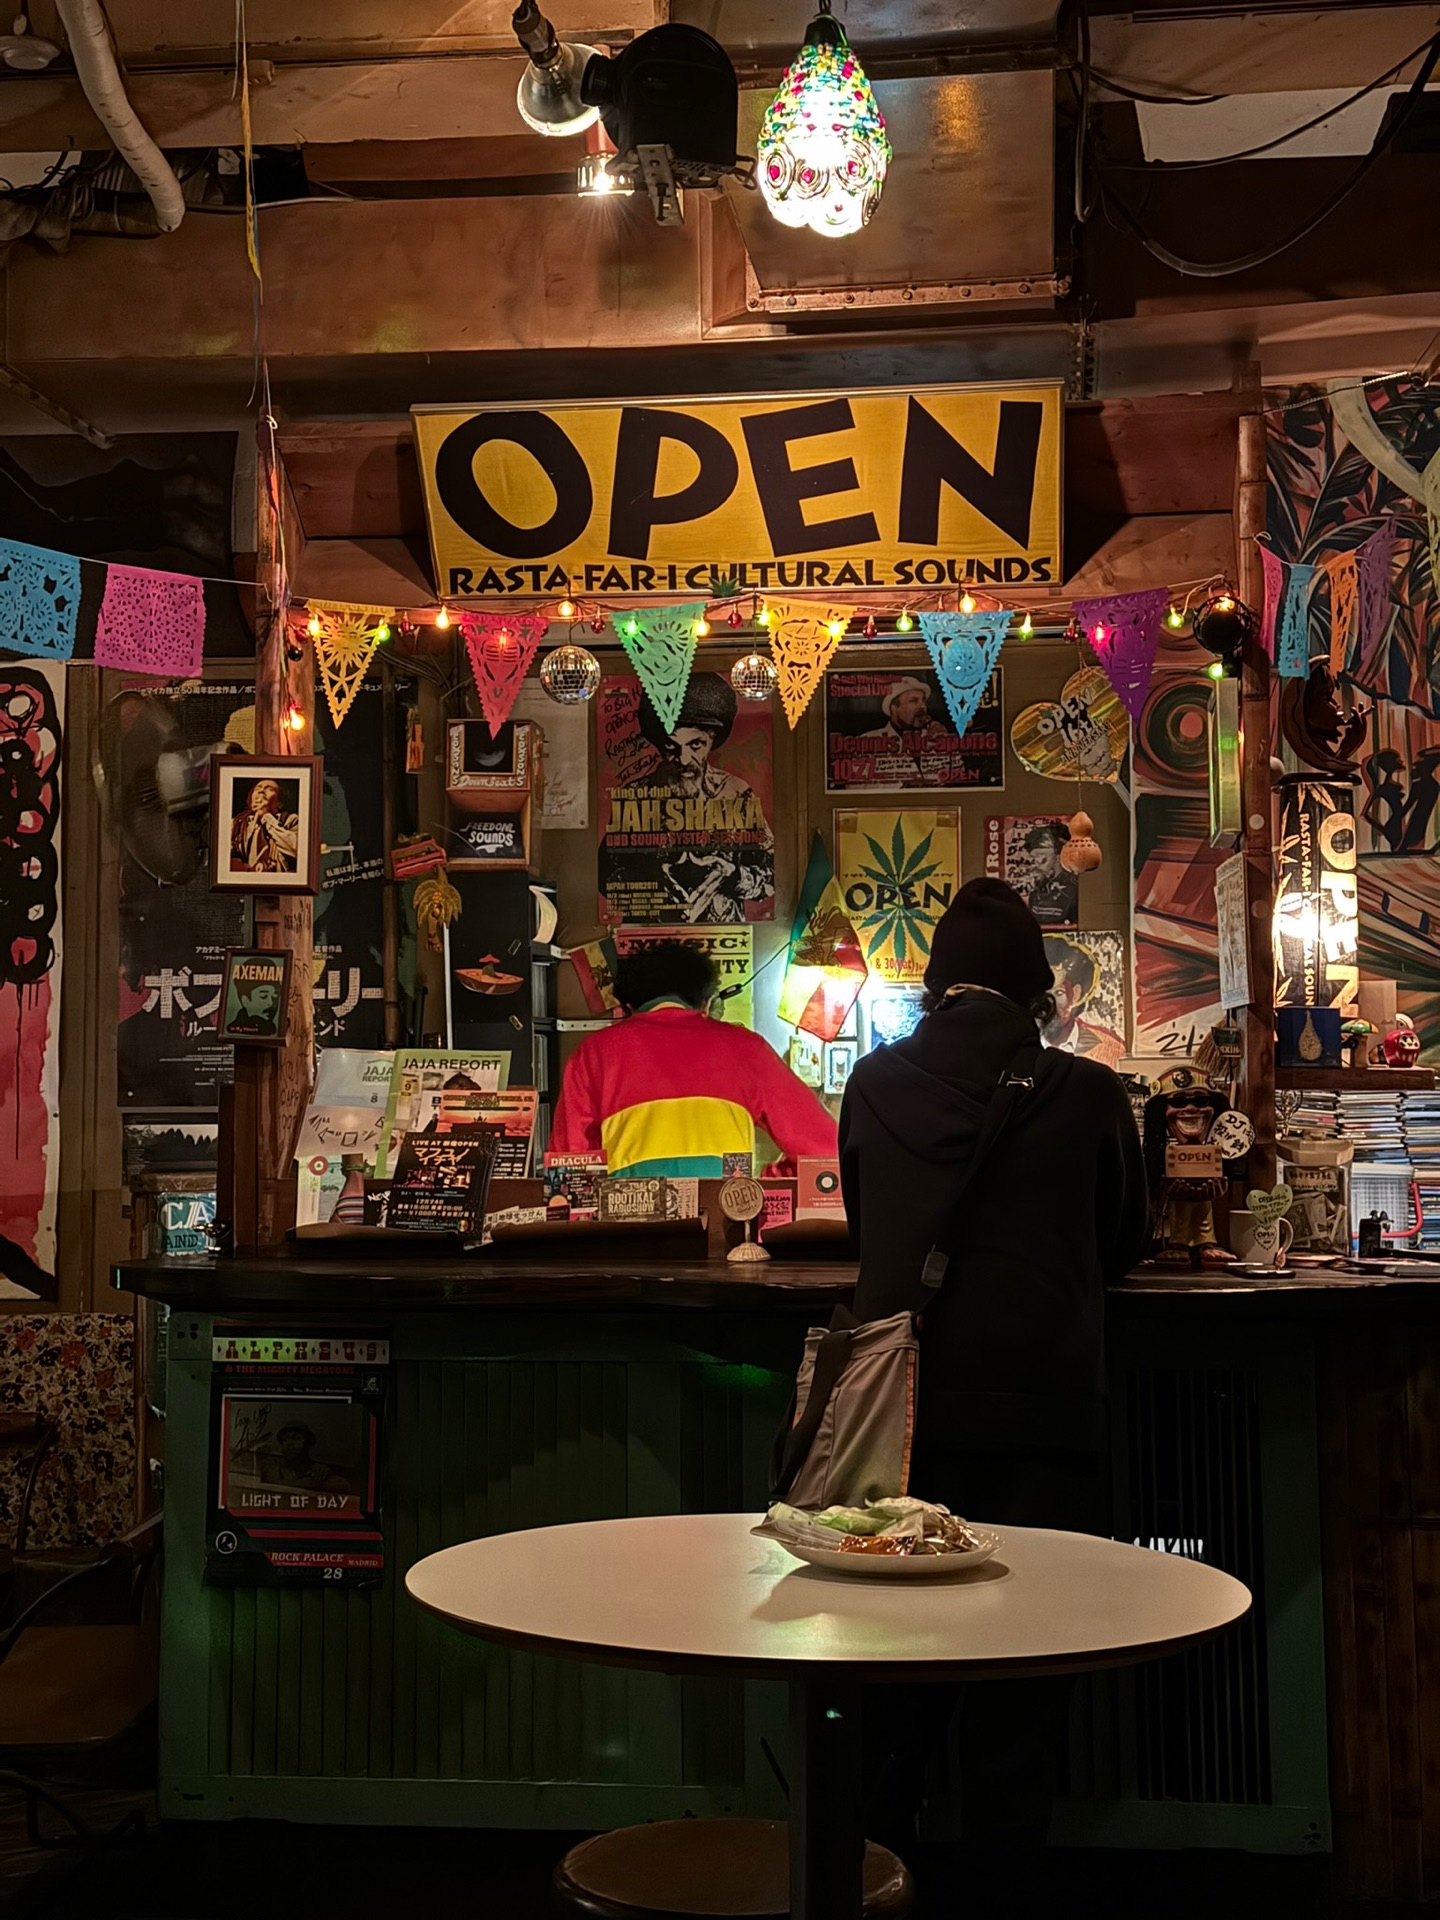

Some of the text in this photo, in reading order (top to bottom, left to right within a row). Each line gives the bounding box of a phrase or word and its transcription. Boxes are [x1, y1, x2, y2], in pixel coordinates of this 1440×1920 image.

[436, 394, 1043, 559] OPEN
[449, 559, 677, 594] RASTA-FAR-I
[894, 556, 1052, 586] SOUNDS
[1037, 688, 1096, 736] OPEN
[831, 733, 900, 753] Dennis
[1059, 719, 1111, 763] ANNIVERSARY
[937, 767, 980, 786] OPEN
[606, 797, 765, 833] JAH SHAKA
[986, 819, 1000, 868] Rose
[1299, 813, 1312, 897] RASTA-FAR-I
[845, 881, 952, 912] OPEN
[1318, 812, 1359, 1018] OPEN
[233, 963, 283, 982] AXEMAN
[364, 1066, 394, 1076] JAJA
[402, 1058, 502, 1071] JAJA REPORT
[404, 1083, 412, 1092] 9
[370, 1095, 379, 1104] 8
[550, 1155, 602, 1167] DRACULA
[1177, 1151, 1212, 1162] OPEN
[608, 1191, 655, 1205] ROOTIKAL
[724, 1184, 758, 1208] OPEN
[608, 1202, 655, 1214] RADIOSHOW
[226, 1340, 378, 1361] ALPHEUS
[241, 1493, 349, 1509] LIGHT OF DAY
[271, 1552, 300, 1561] ROCK
[303, 1552, 344, 1562] PALACE
[322, 1567, 343, 1580] 28
